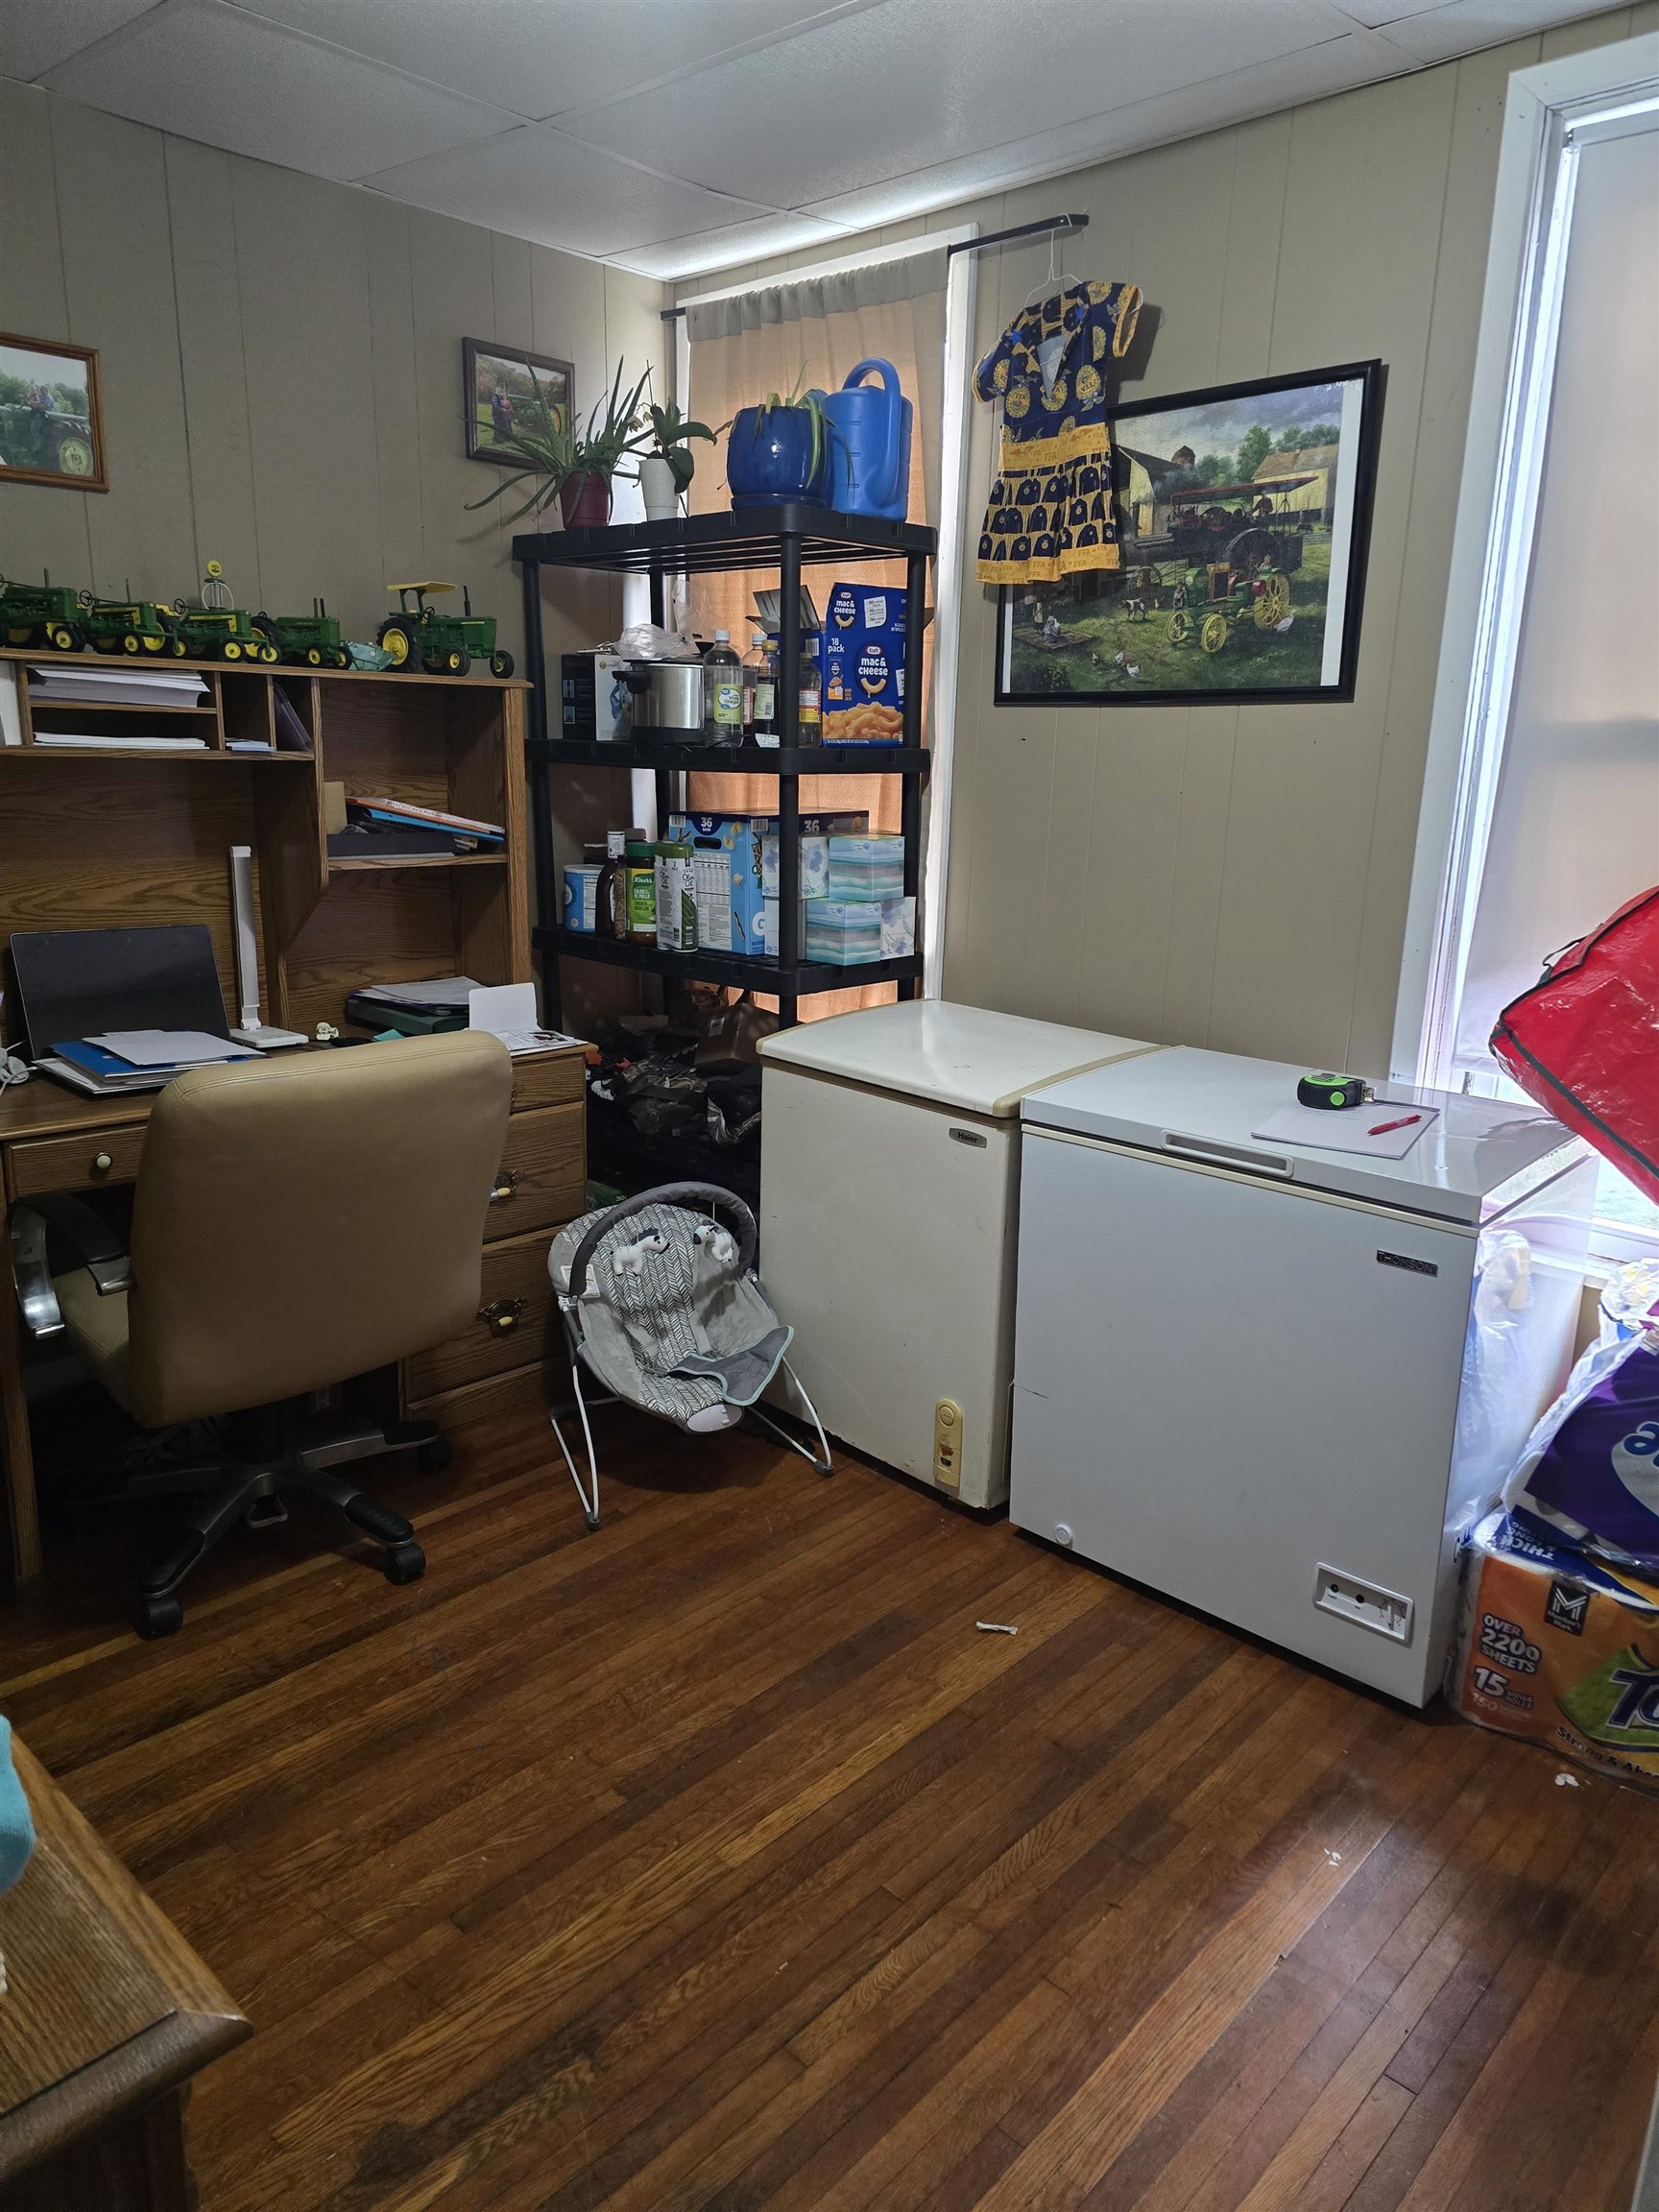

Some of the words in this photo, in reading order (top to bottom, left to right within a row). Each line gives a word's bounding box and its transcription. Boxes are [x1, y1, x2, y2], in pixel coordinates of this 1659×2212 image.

[828, 644, 845, 654] pack
[831, 637, 839, 646] 18
[701, 817, 712, 828] 36
[804, 819, 820, 833] 36
[957, 1132, 977, 1142] Haier
[1378, 1251, 1437, 1274] THOMSON
[1483, 1615, 1522, 1636] OVER
[1481, 1627, 1541, 1662] 2200
[1481, 1646, 1537, 1673] SHEETS
[1476, 1667, 1508, 1696] 15
